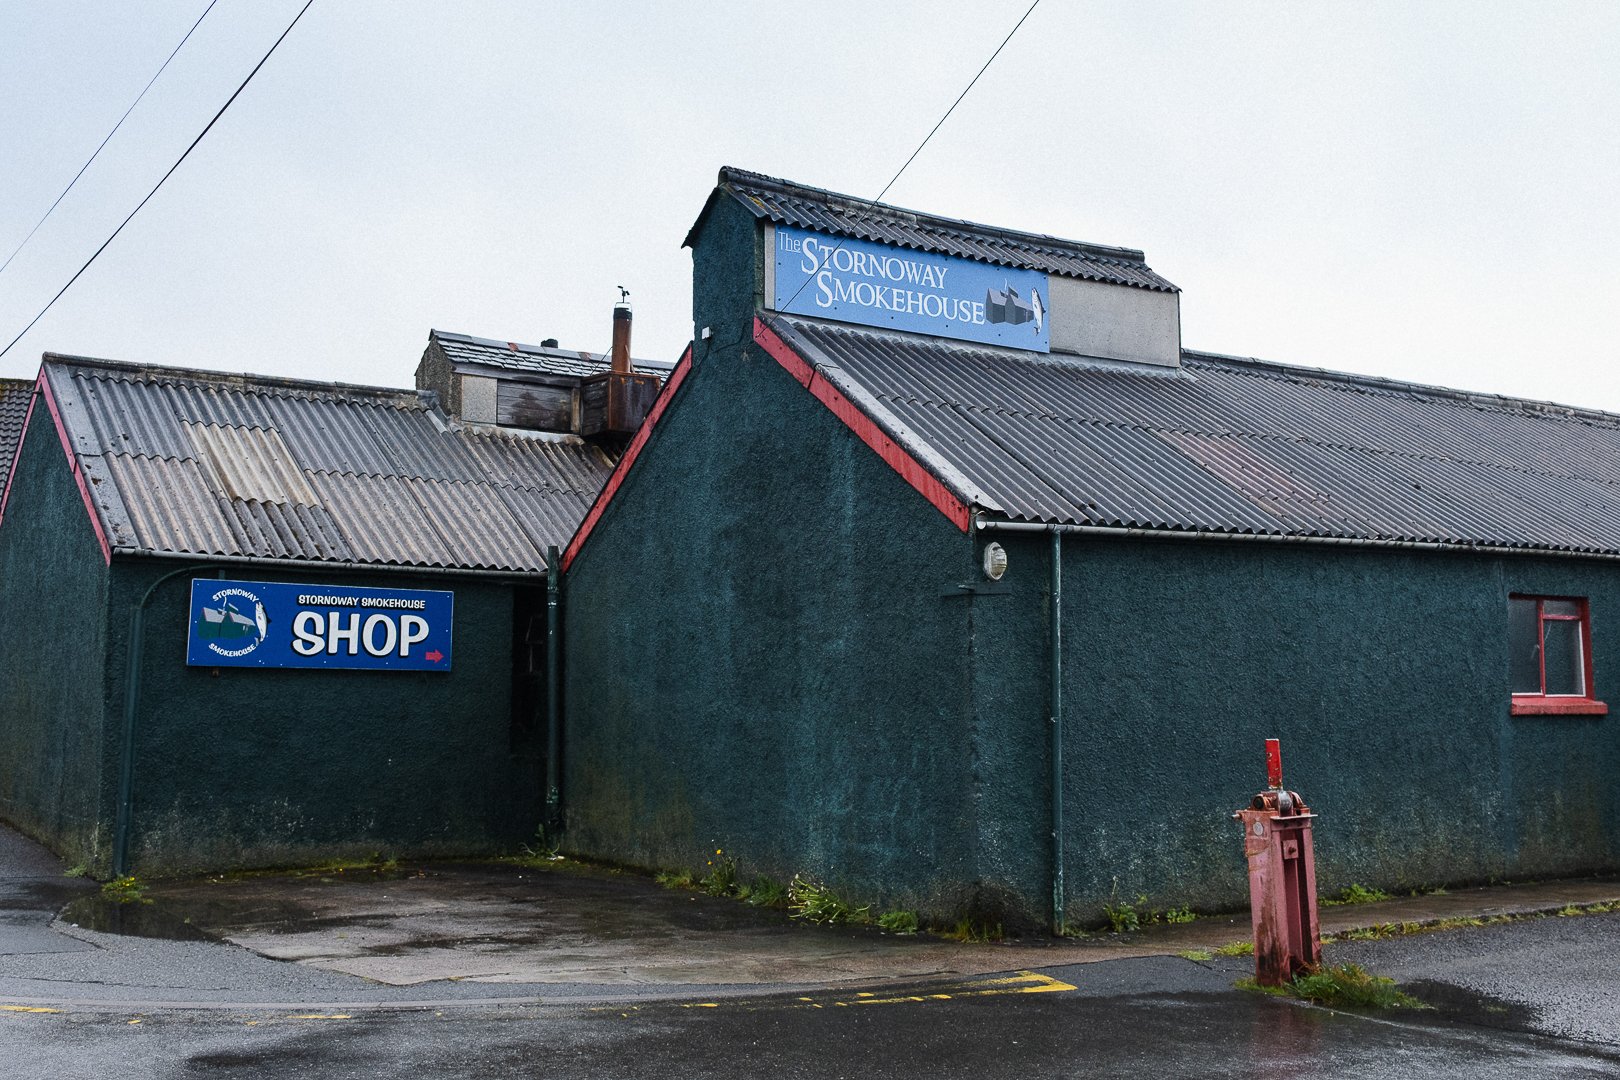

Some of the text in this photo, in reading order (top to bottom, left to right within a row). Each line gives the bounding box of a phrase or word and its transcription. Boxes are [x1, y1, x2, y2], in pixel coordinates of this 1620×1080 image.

[778, 231, 949, 290] The STORNOWAY
[815, 271, 986, 326] SMOKEHOUSE
[212, 588, 260, 602] STORNOWAY
[298, 594, 426, 609] STORNOWAY SMOKEHOUSE
[292, 611, 430, 657] SHOP
[208, 643, 257, 657] SMOKEHOUSE
